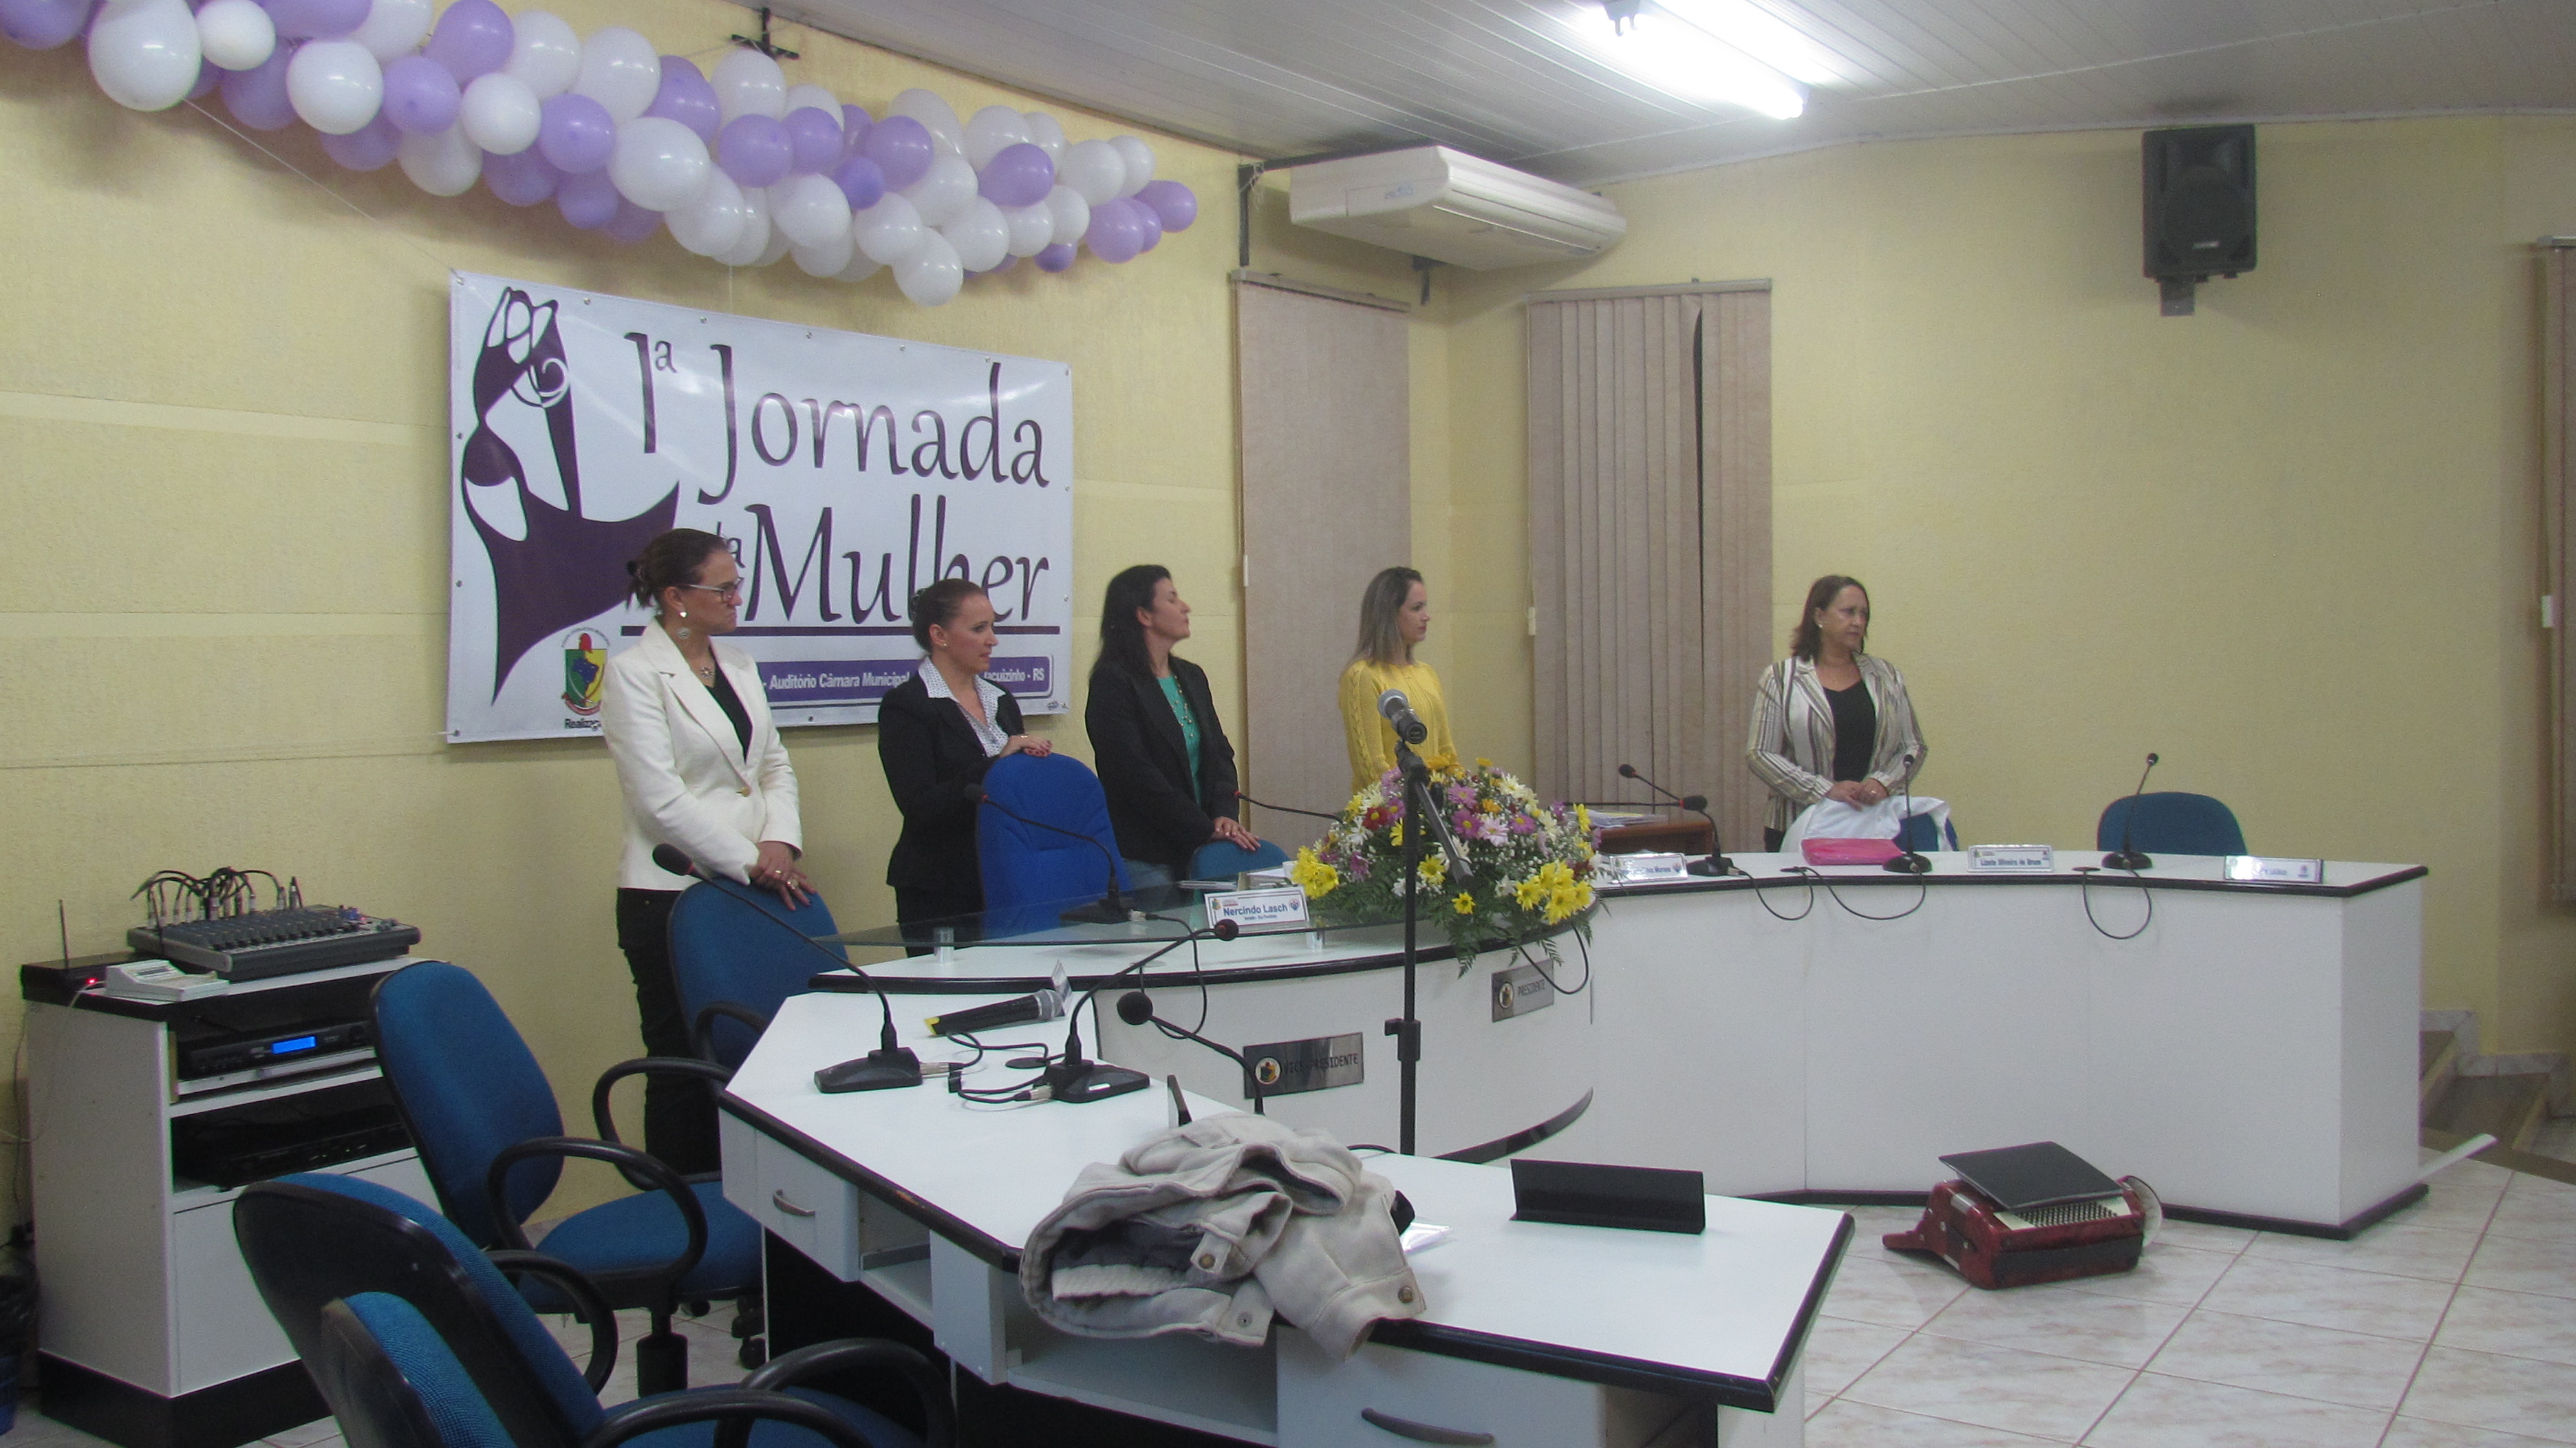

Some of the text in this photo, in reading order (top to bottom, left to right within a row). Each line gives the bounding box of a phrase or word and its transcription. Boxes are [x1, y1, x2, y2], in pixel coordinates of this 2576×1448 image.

[697, 343, 1051, 505] Jornada
[744, 493, 1051, 625] Mulher
[769, 673, 817, 690] Auditório
[819, 672, 860, 688] Câmara
[861, 671, 910, 688] Municipal
[1033, 668, 1045, 681] RS
[1223, 902, 1288, 917] Nercindo Lasch
